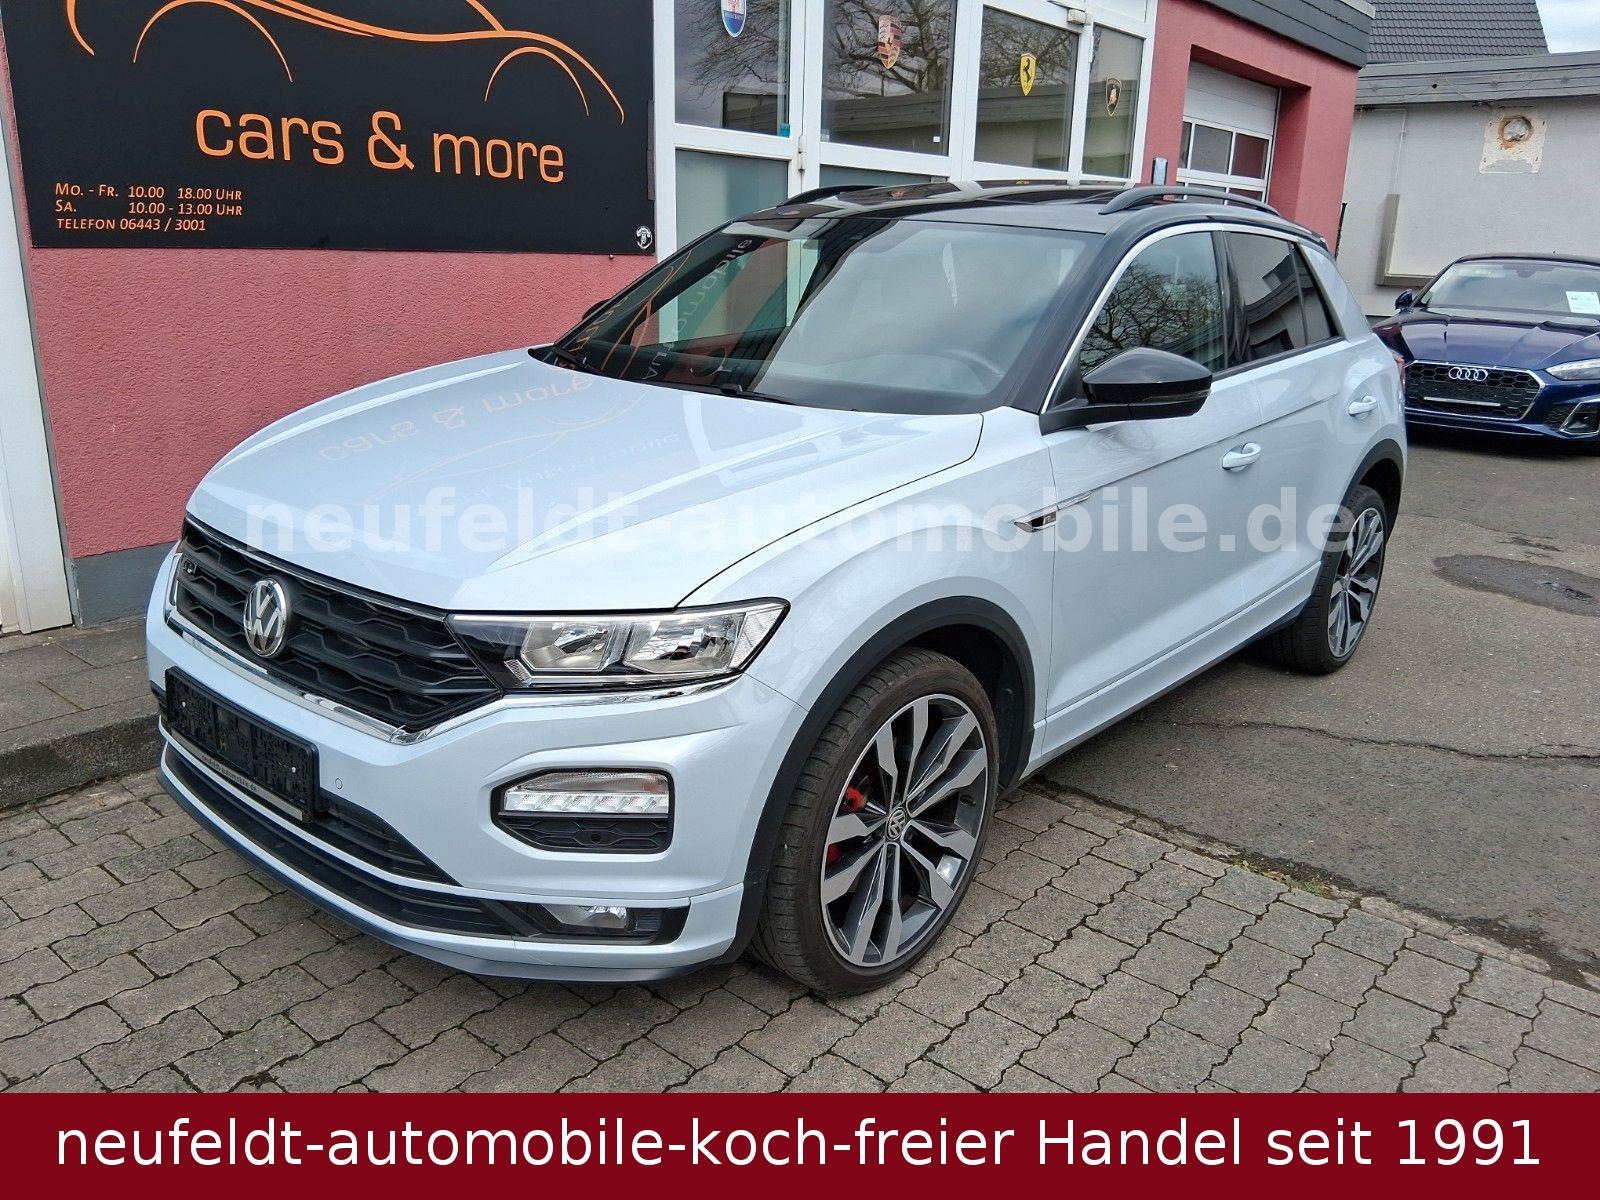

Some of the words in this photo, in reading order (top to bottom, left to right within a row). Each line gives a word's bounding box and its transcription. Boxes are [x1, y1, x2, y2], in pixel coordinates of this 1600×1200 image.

[196, 110, 344, 164] cars
[368, 111, 414, 170] &
[434, 133, 563, 182] more
[128, 186, 164, 198] 10.00
[178, 188, 211, 199] 18.00
[129, 202, 164, 214] 10.00
[179, 204, 212, 214] 13.00
[57, 219, 115, 229] TELEFON
[120, 219, 160, 230] 06443
[165, 218, 171, 231] /
[175, 220, 205, 230] 3001
